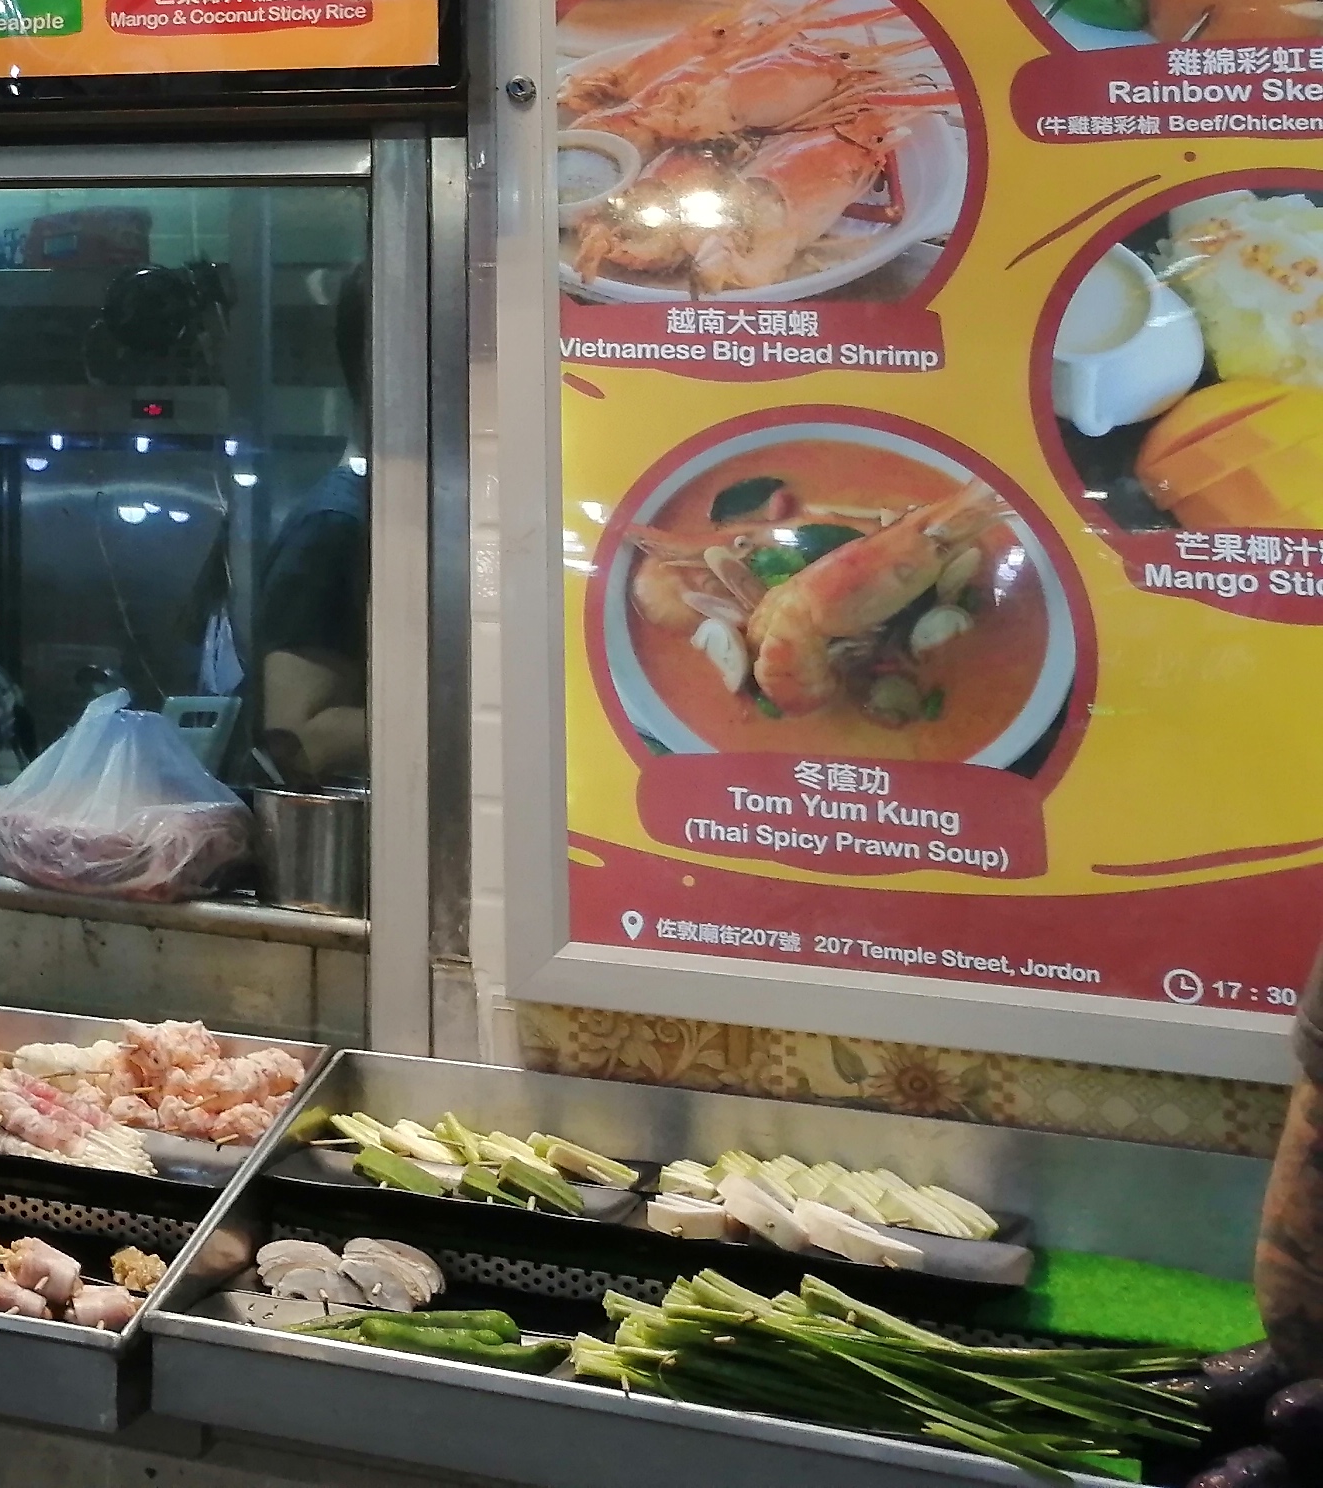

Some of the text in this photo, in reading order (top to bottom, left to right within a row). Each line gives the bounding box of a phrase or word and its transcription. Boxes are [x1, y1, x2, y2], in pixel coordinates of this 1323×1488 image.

[110, 3, 367, 30] Mango & Coconut Sticky Rice
[1108, 78, 1323, 104] Rainbow Ske
[1168, 114, 1323, 133] Beef/Chicken
[666, 308, 820, 338] 越南大頭蝦
[559, 336, 939, 374] Vietnamese Big Head Shrimp
[1175, 531, 1323, 567] 芒果椰汁
[1144, 563, 1259, 598] Mango
[727, 785, 961, 837] Tom Yum Kung
[683, 817, 1010, 873] (Thai Spicy Prawn Soup)
[656, 916, 1101, 984] 佐敦廟街207號 207 Temple Street, Jordon
